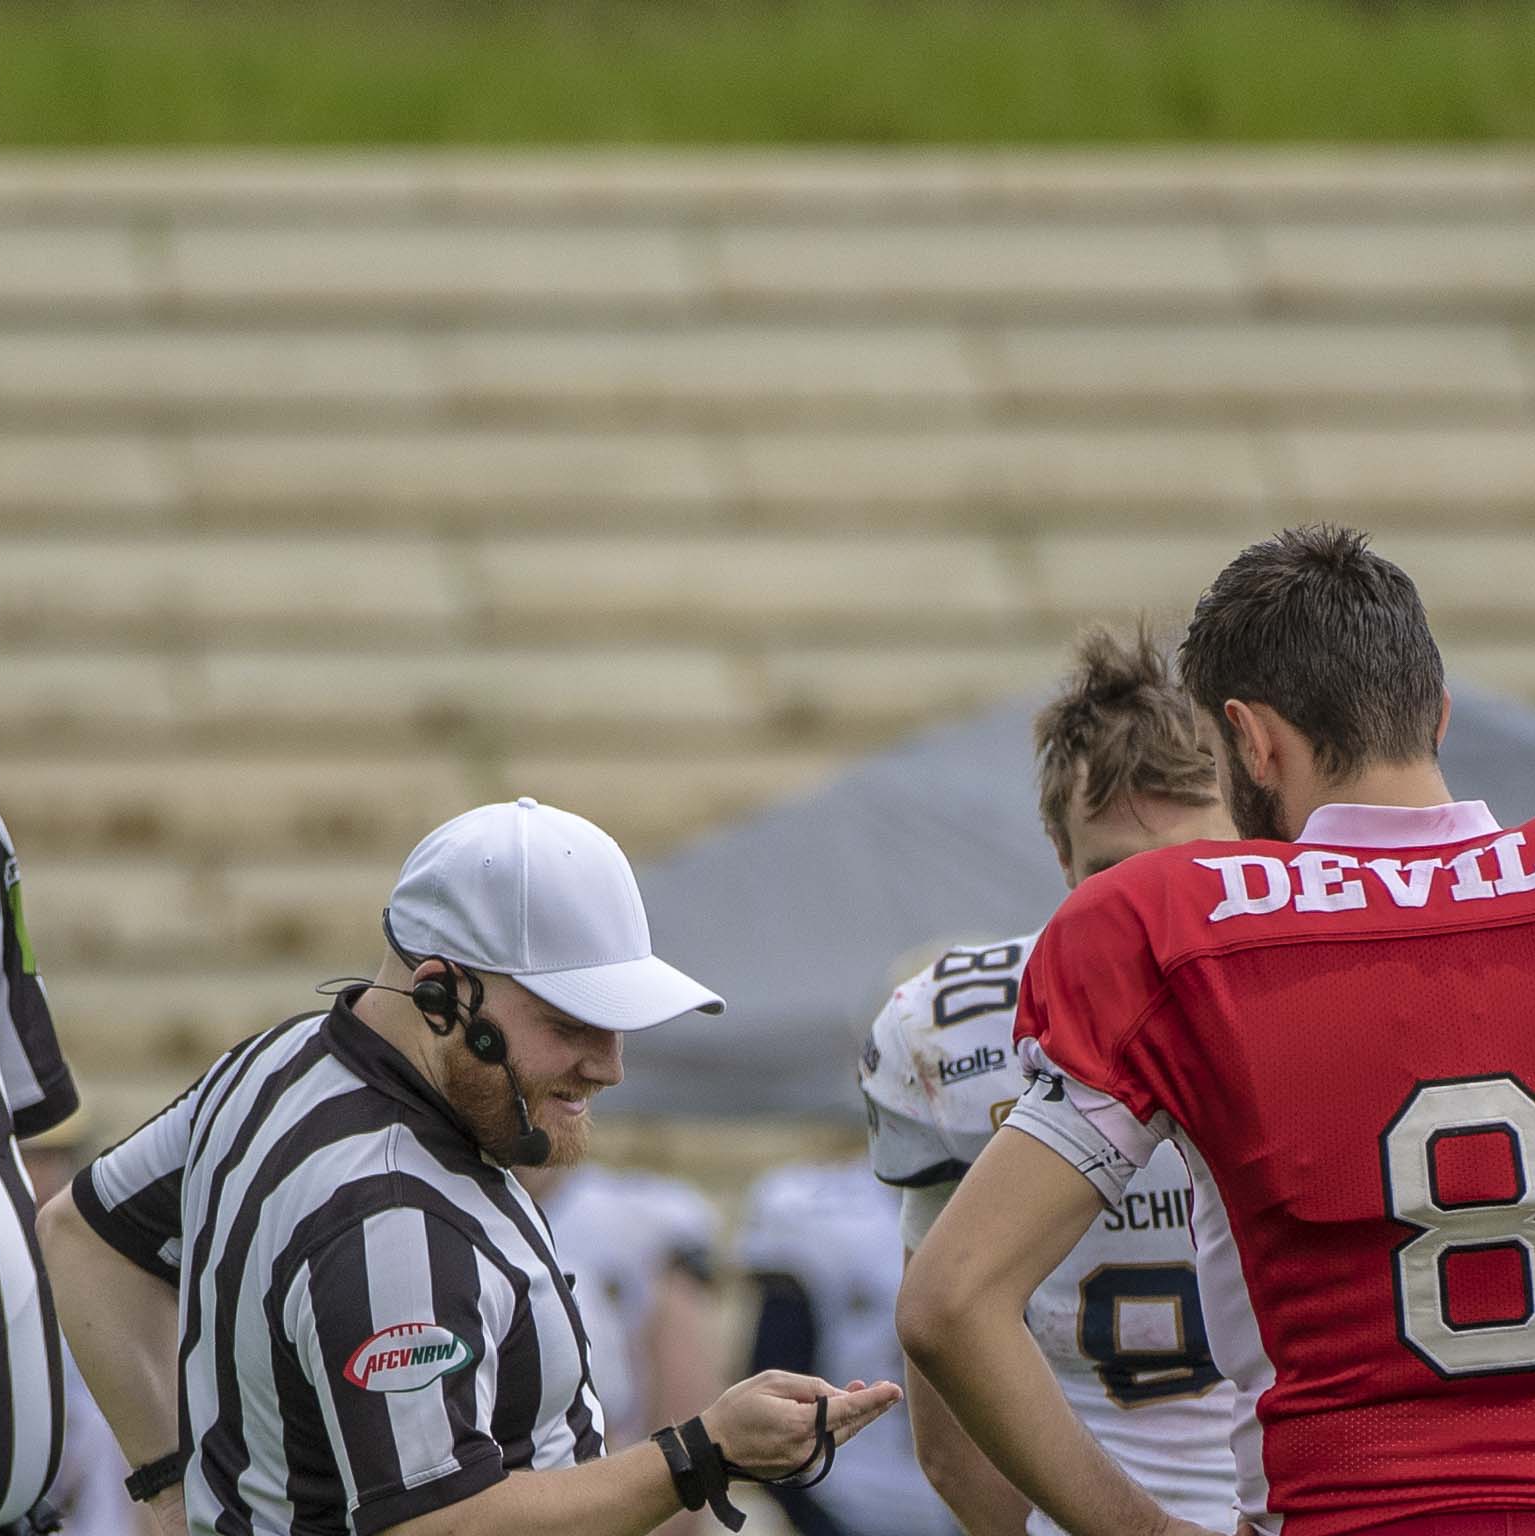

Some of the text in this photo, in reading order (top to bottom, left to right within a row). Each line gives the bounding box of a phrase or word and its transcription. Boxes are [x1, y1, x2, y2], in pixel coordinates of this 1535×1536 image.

[933, 944, 1021, 1030] 80
[938, 1044, 1005, 1080] kolb
[365, 1342, 454, 1376] AFCVNRW
